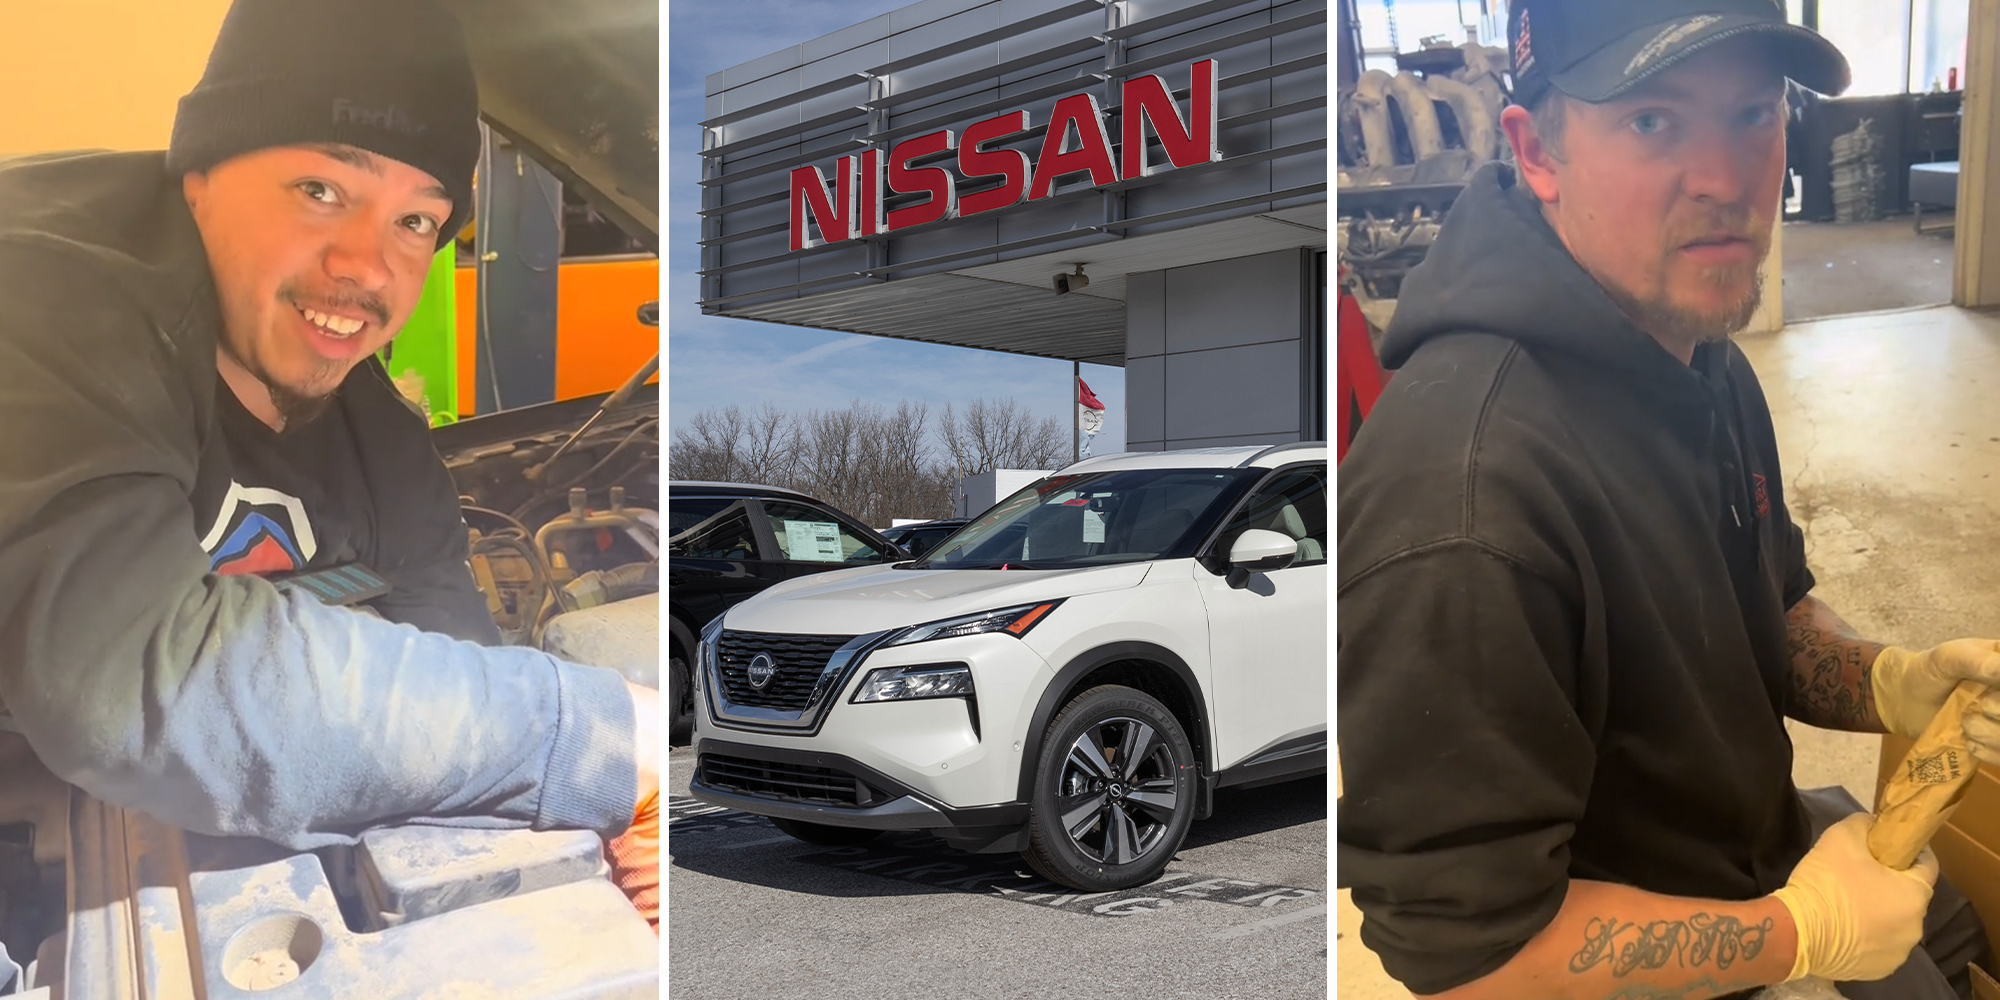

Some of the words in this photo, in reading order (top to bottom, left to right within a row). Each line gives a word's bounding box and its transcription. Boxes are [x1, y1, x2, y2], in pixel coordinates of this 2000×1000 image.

[789, 59, 1219, 251] NISSAN
[1947, 751, 1959, 769] SCAN
[1076, 864, 1130, 882] DUNLOP
